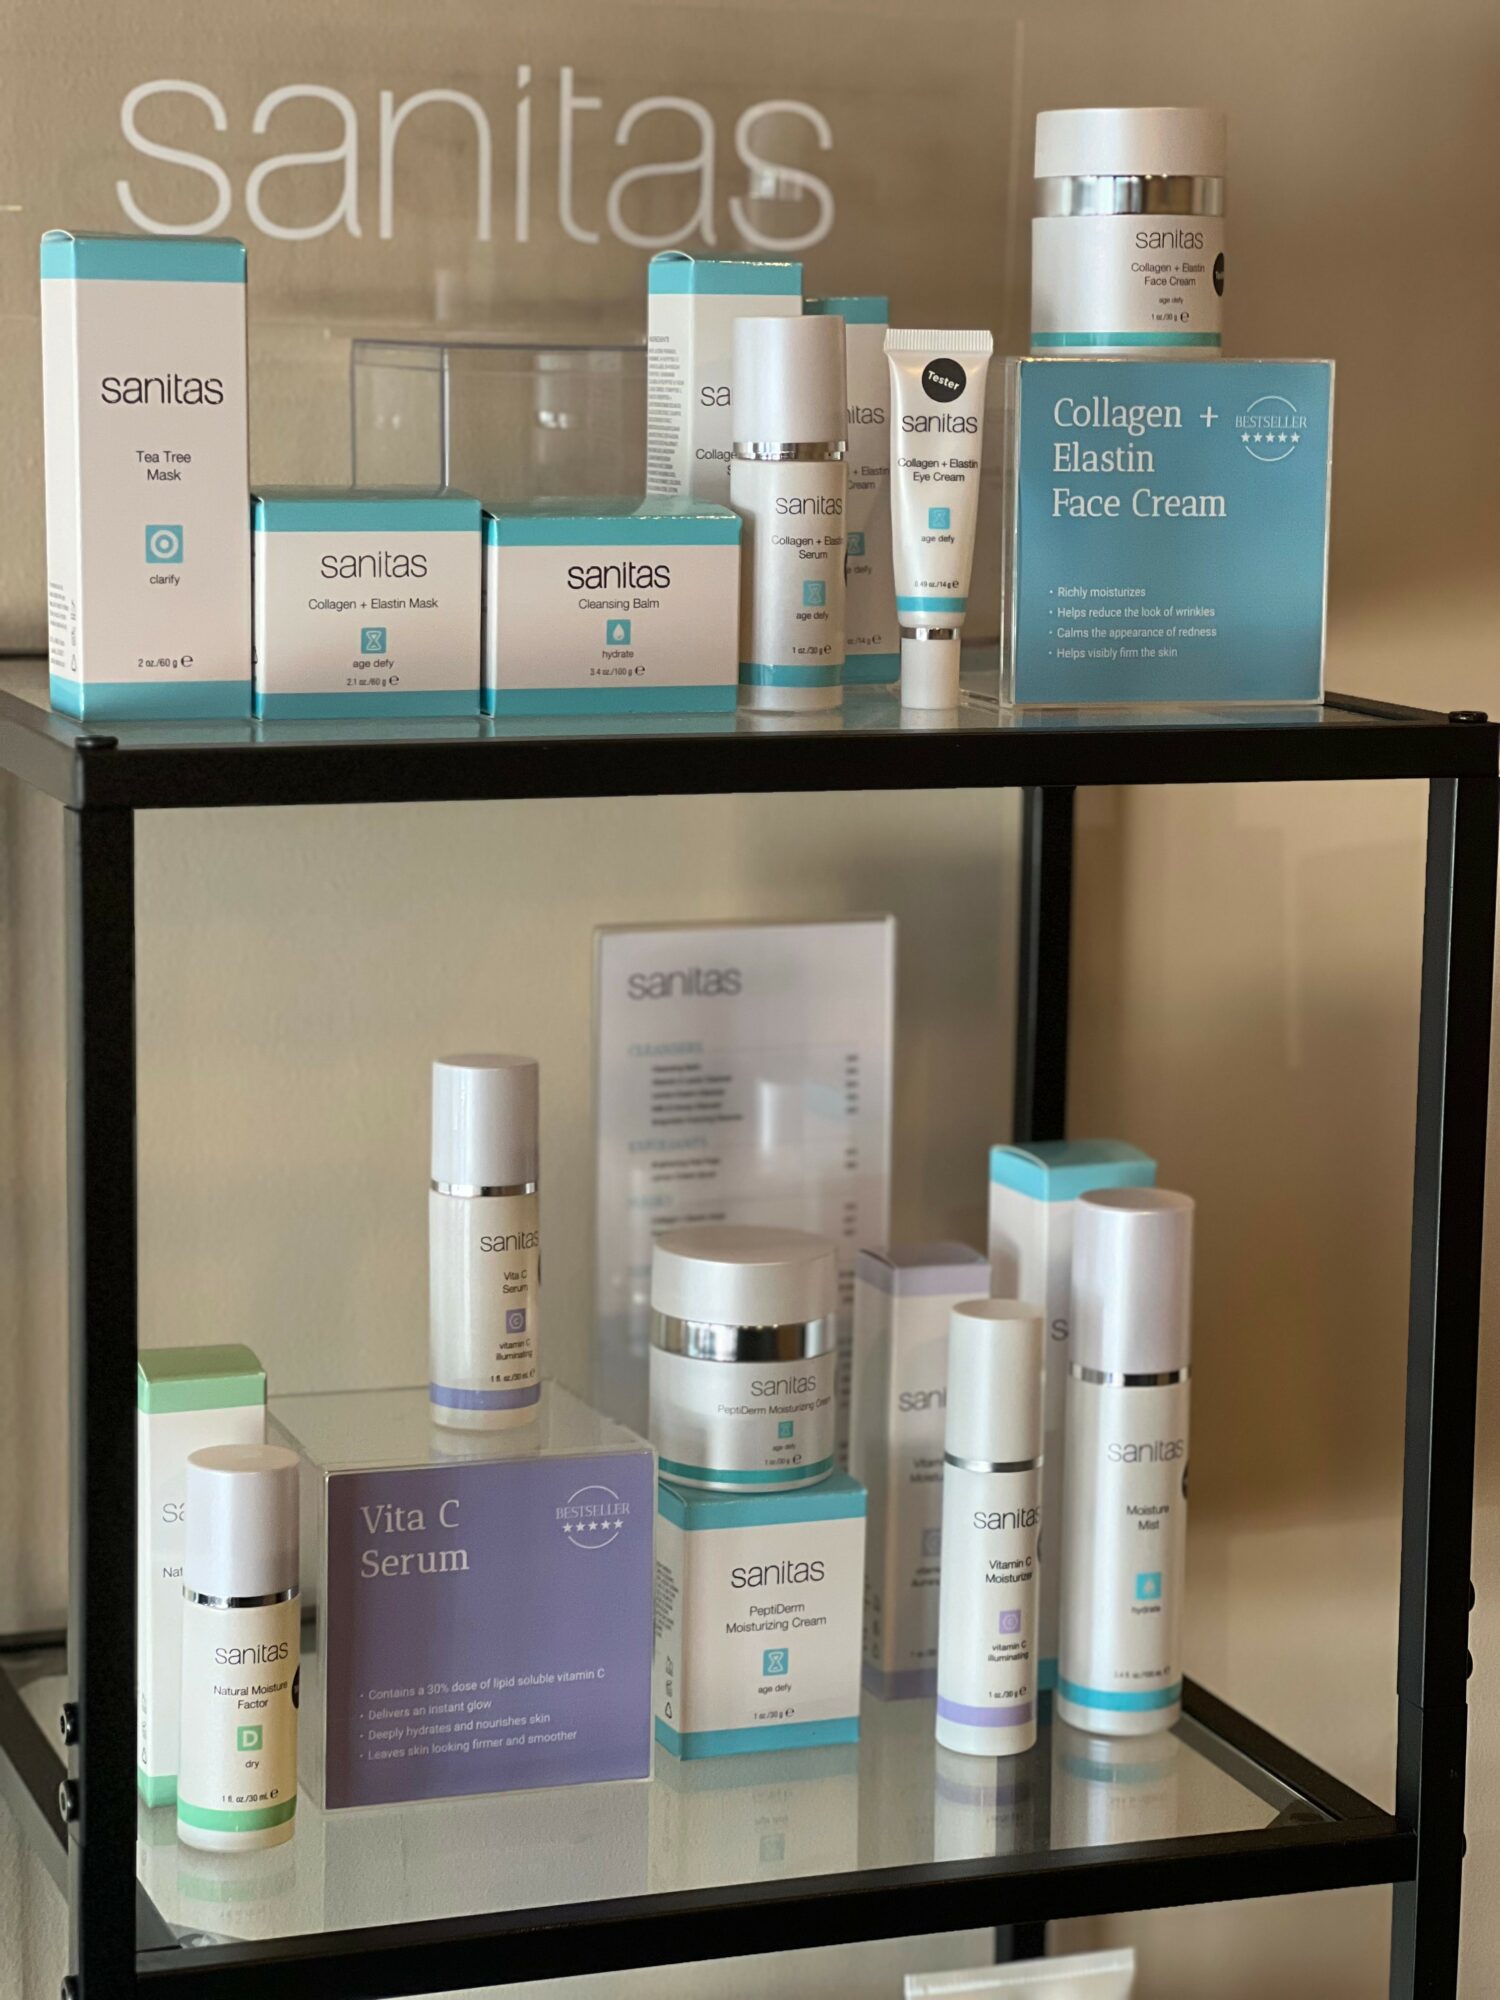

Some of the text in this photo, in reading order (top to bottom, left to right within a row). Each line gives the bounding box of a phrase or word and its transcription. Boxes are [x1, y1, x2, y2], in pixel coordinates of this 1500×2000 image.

[116, 65, 834, 249] sanitas
[1136, 229, 1203, 249] sanitas
[1131, 263, 1171, 273] Collagen
[1144, 276, 1196, 286] Face Cream
[928, 370, 959, 390] Tester
[102, 373, 224, 404] sanitas
[902, 414, 977, 433] sanitas
[1053, 396, 1218, 437] Collagen +
[1235, 415, 1308, 429] BESTSELLER
[136, 450, 191, 463] Tea Tree
[696, 448, 737, 462] Collage
[1053, 441, 1155, 472] Elastin
[898, 458, 939, 469] Collagen
[950, 459, 978, 468] Elastin
[147, 469, 181, 481] Mask
[913, 472, 964, 483] Eye Cream
[775, 496, 842, 515] sanitas
[1052, 488, 1227, 517] Face Cream
[772, 536, 813, 547] Collagen
[921, 535, 955, 544] age defy
[799, 550, 828, 559] Serum
[321, 551, 427, 578] sanitas
[150, 574, 180, 586] clarify
[567, 562, 670, 589] sanitas
[1058, 587, 1146, 599] Richly moisturizes
[308, 598, 356, 612] Collagen
[371, 598, 406, 609] Elastin
[409, 598, 438, 608] Mask
[579, 598, 659, 611] Cleansing Balm
[796, 612, 811, 620] age
[1057, 606, 1215, 619] Helps reduce the look of wrinkles
[1057, 626, 1217, 639] Calms the appearance of redness
[602, 650, 634, 660] hydrate
[1057, 647, 1178, 660] Helps visibly firm the skin
[138, 659, 143, 667] 2
[173, 660, 177, 668] g
[353, 659, 394, 669] age defy
[628, 967, 742, 1000] sanitas
[480, 1231, 539, 1252] sanitas
[504, 1270, 527, 1281] Vita C
[503, 1284, 528, 1294] Serum
[751, 1375, 816, 1396] sanitas
[718, 1404, 766, 1415] PeptiDerm
[1108, 1439, 1184, 1464] sanitas
[556, 1502, 630, 1520] BESTSELLER
[1126, 1504, 1170, 1515] Moisture
[360, 1500, 460, 1534] Vita C
[1138, 1520, 1160, 1530] Mist
[360, 1548, 470, 1578] Serum
[989, 1556, 1032, 1570] Vitamin C
[731, 1560, 825, 1588] sanitas
[750, 1603, 804, 1617] PeptiDerm
[726, 1615, 827, 1634] Moisturizing Cream
[215, 1642, 288, 1665] sanitas
[213, 1685, 248, 1696] Natural
[252, 1681, 288, 1694] Moisture
[369, 1668, 606, 1700] Contains a 30% dose of lipid soluble vitamin C
[758, 1683, 792, 1694] age defy
[238, 1700, 269, 1710] Factor
[369, 1700, 492, 1720] Delivers an instant glow
[369, 1713, 550, 1741] Deeply hydrates and nourishes skin
[242, 1730, 258, 1747] D
[368, 1730, 577, 1760] Leaves skin looking firmer and smoother
[245, 1760, 260, 1769] dry
